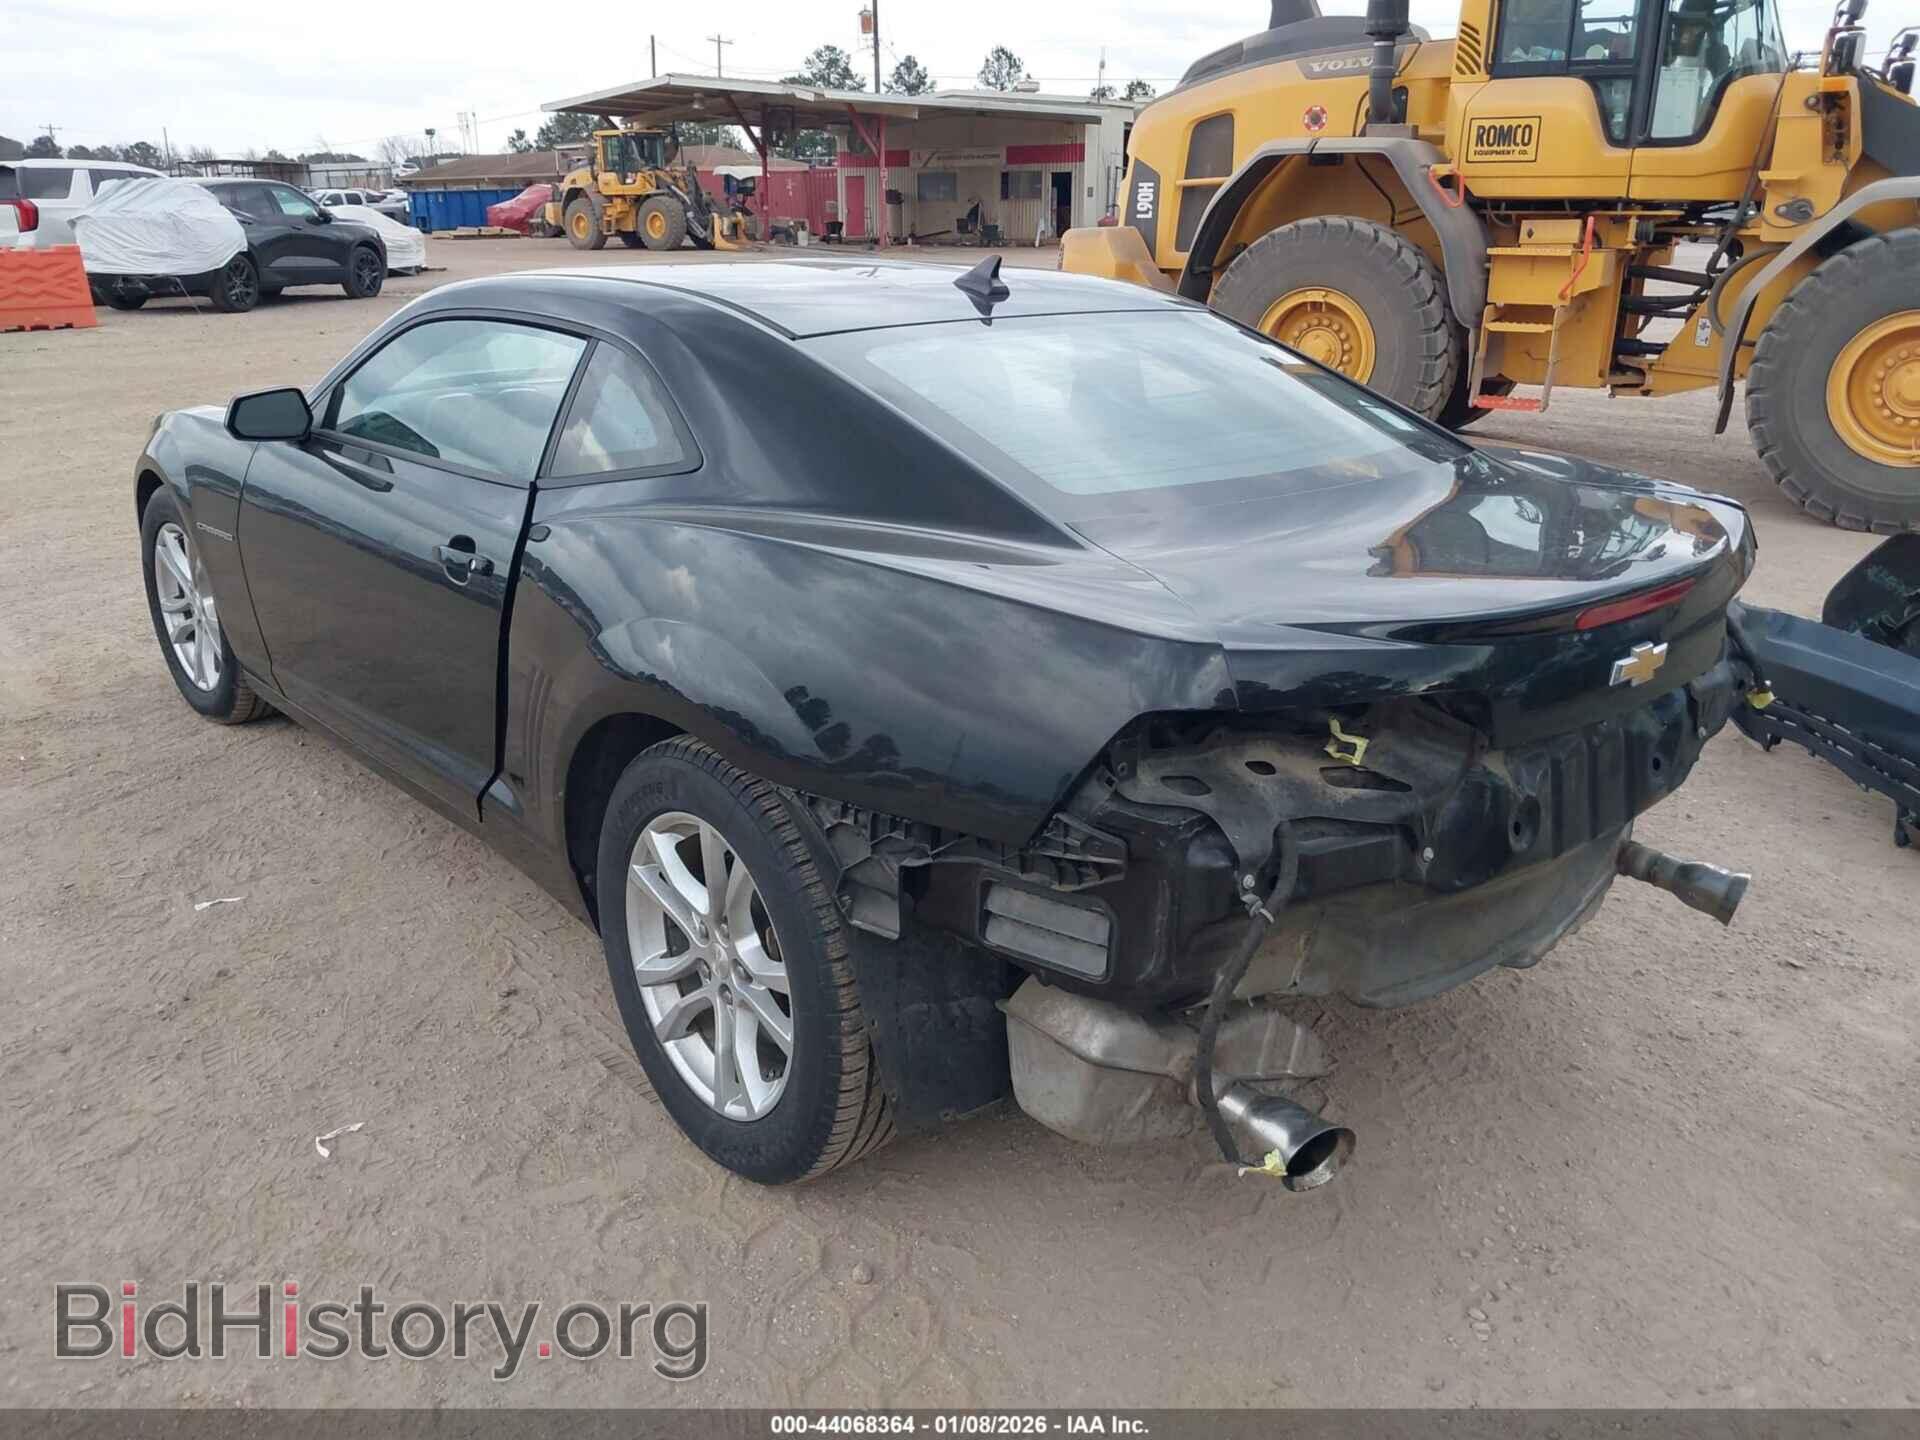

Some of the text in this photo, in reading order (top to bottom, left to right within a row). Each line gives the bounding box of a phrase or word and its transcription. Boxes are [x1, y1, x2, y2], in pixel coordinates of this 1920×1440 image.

[1310, 55, 1376, 73] VOLV
[1475, 124, 1533, 147] ROMCO
[1136, 182, 1155, 219] L90H
